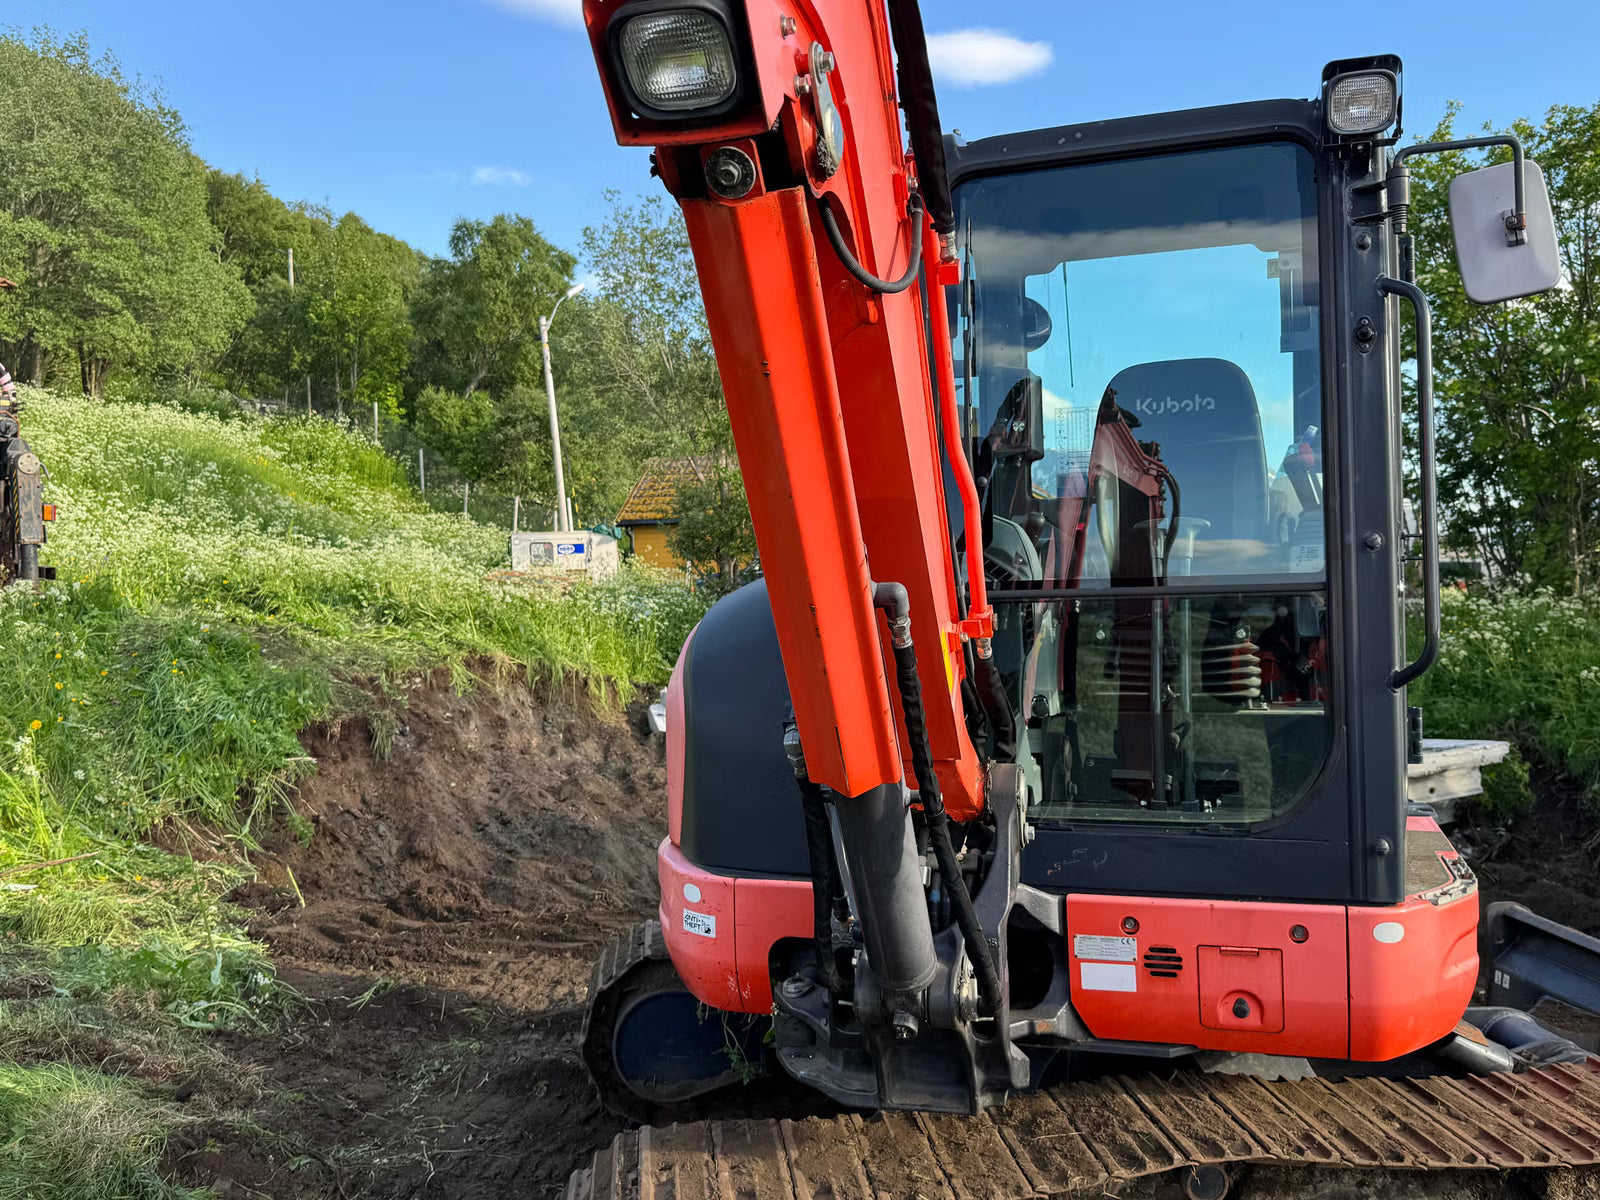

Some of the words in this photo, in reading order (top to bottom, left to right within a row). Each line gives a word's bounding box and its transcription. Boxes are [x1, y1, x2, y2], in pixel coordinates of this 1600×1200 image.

[1136, 394, 1216, 415] Kubota
[684, 920, 701, 930] THEFT
[1121, 937, 1131, 945] CE
